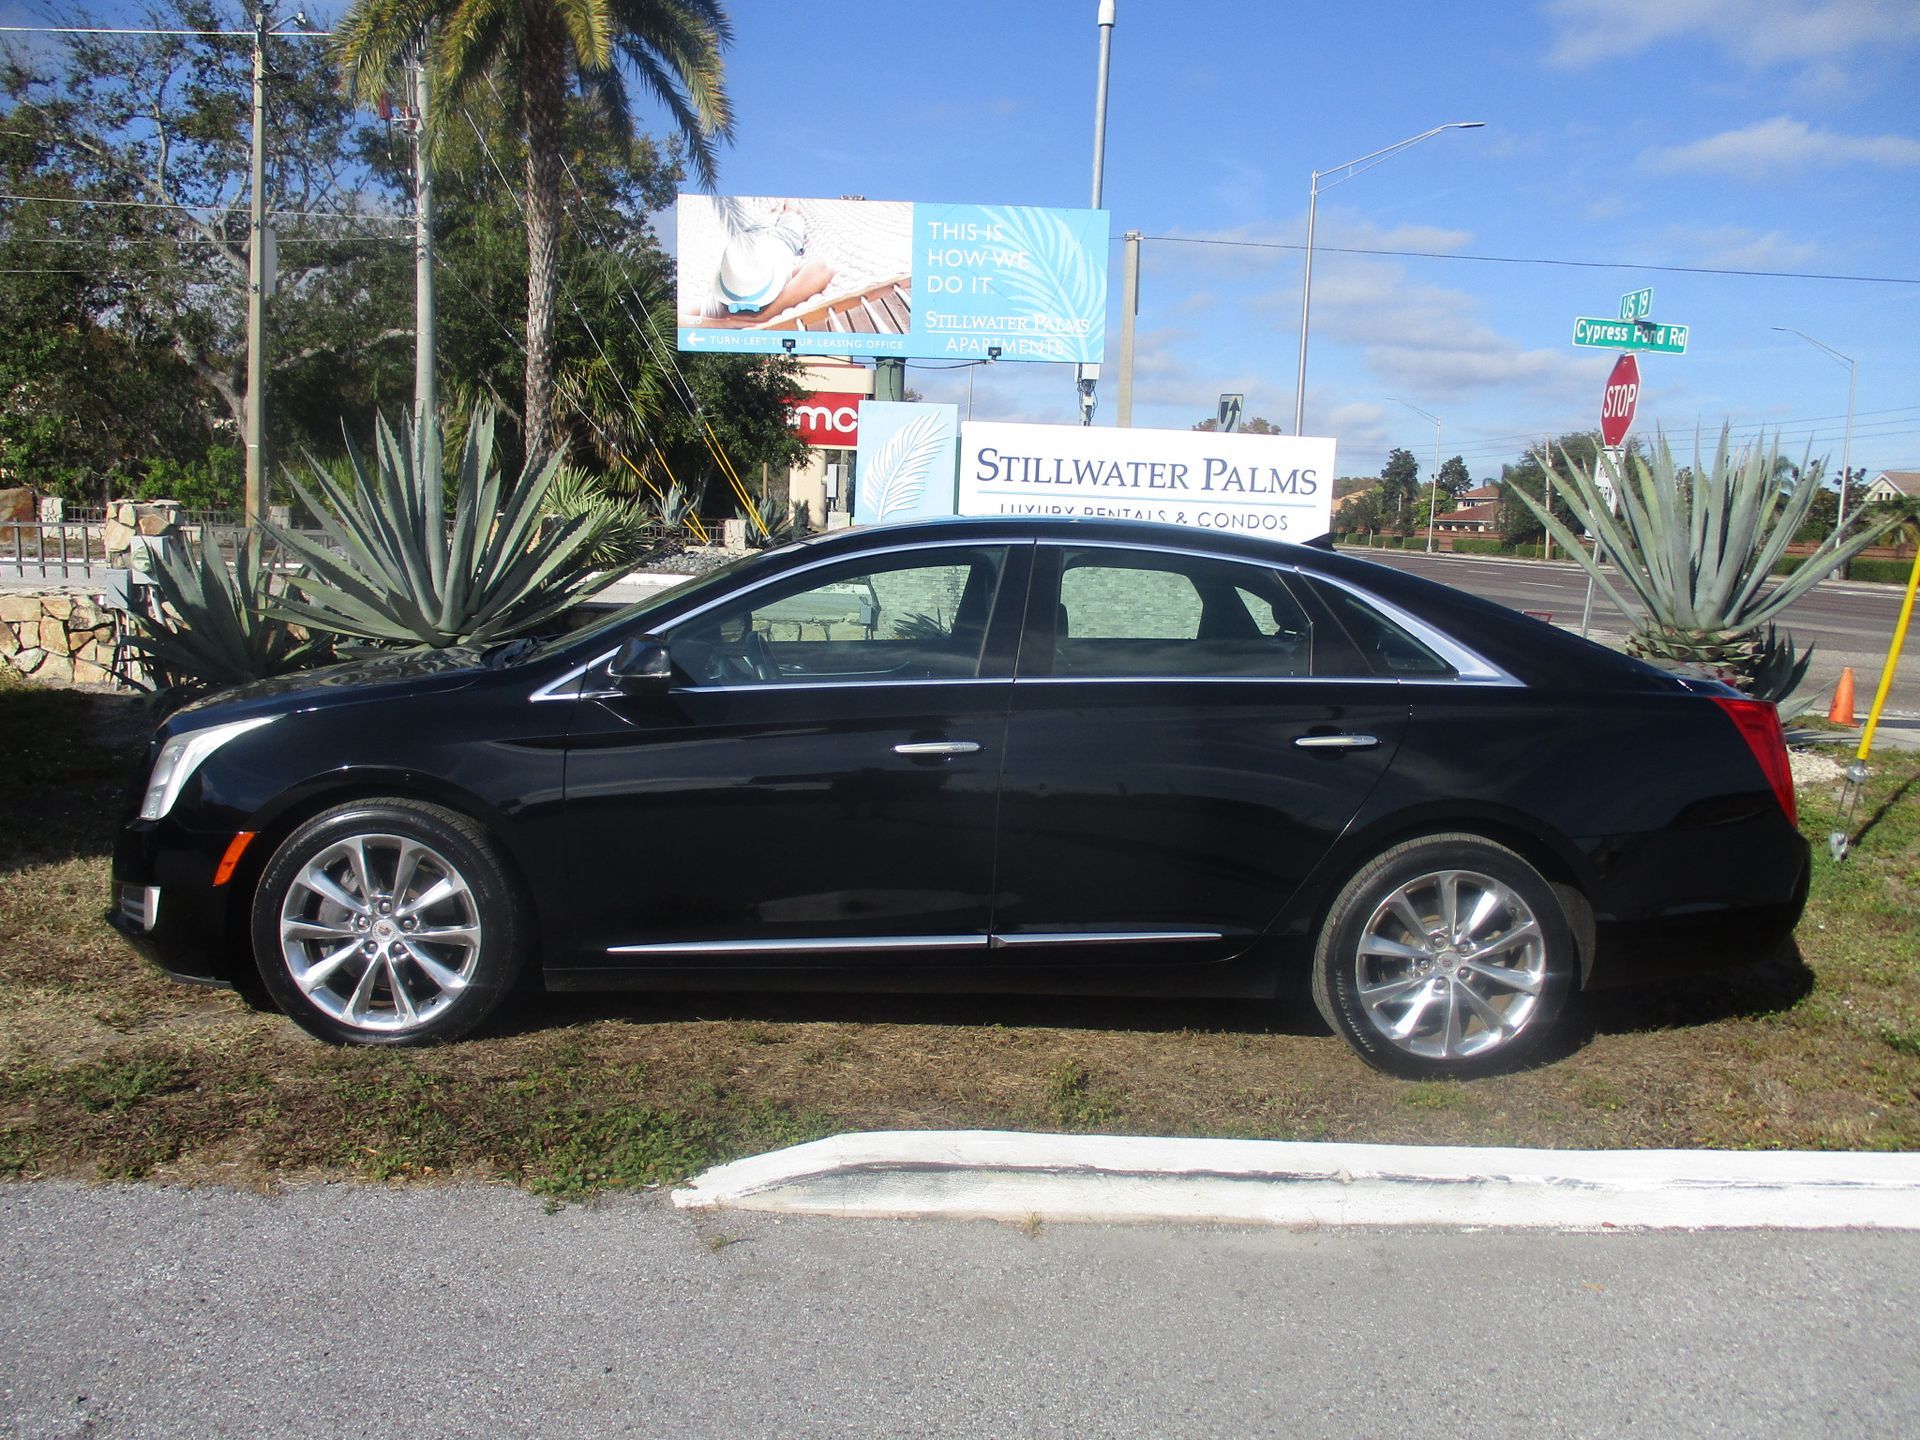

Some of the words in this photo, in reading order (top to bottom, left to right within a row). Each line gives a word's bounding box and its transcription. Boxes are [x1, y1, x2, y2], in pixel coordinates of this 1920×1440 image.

[928, 222, 977, 241] THIS
[986, 224, 1003, 241] IS
[928, 249, 988, 267] HOW
[991, 251, 1029, 269] WE
[927, 275, 963, 294] DO
[1622, 295, 1635, 318] US
[1638, 291, 1649, 315] 19
[925, 310, 1027, 331] STILLWATER
[710, 336, 740, 345] TURN
[744, 337, 767, 346] LEFT
[818, 338, 862, 349] LEASING
[866, 339, 903, 350] OFFICE
[1576, 320, 1628, 344] Cypress
[1669, 327, 1686, 346] Rd
[945, 336, 1065, 356] APARTMENTS
[1604, 384, 1637, 418] STOP
[976, 447, 1189, 490] STILLWATER
[1197, 511, 1288, 531] CONDOS
